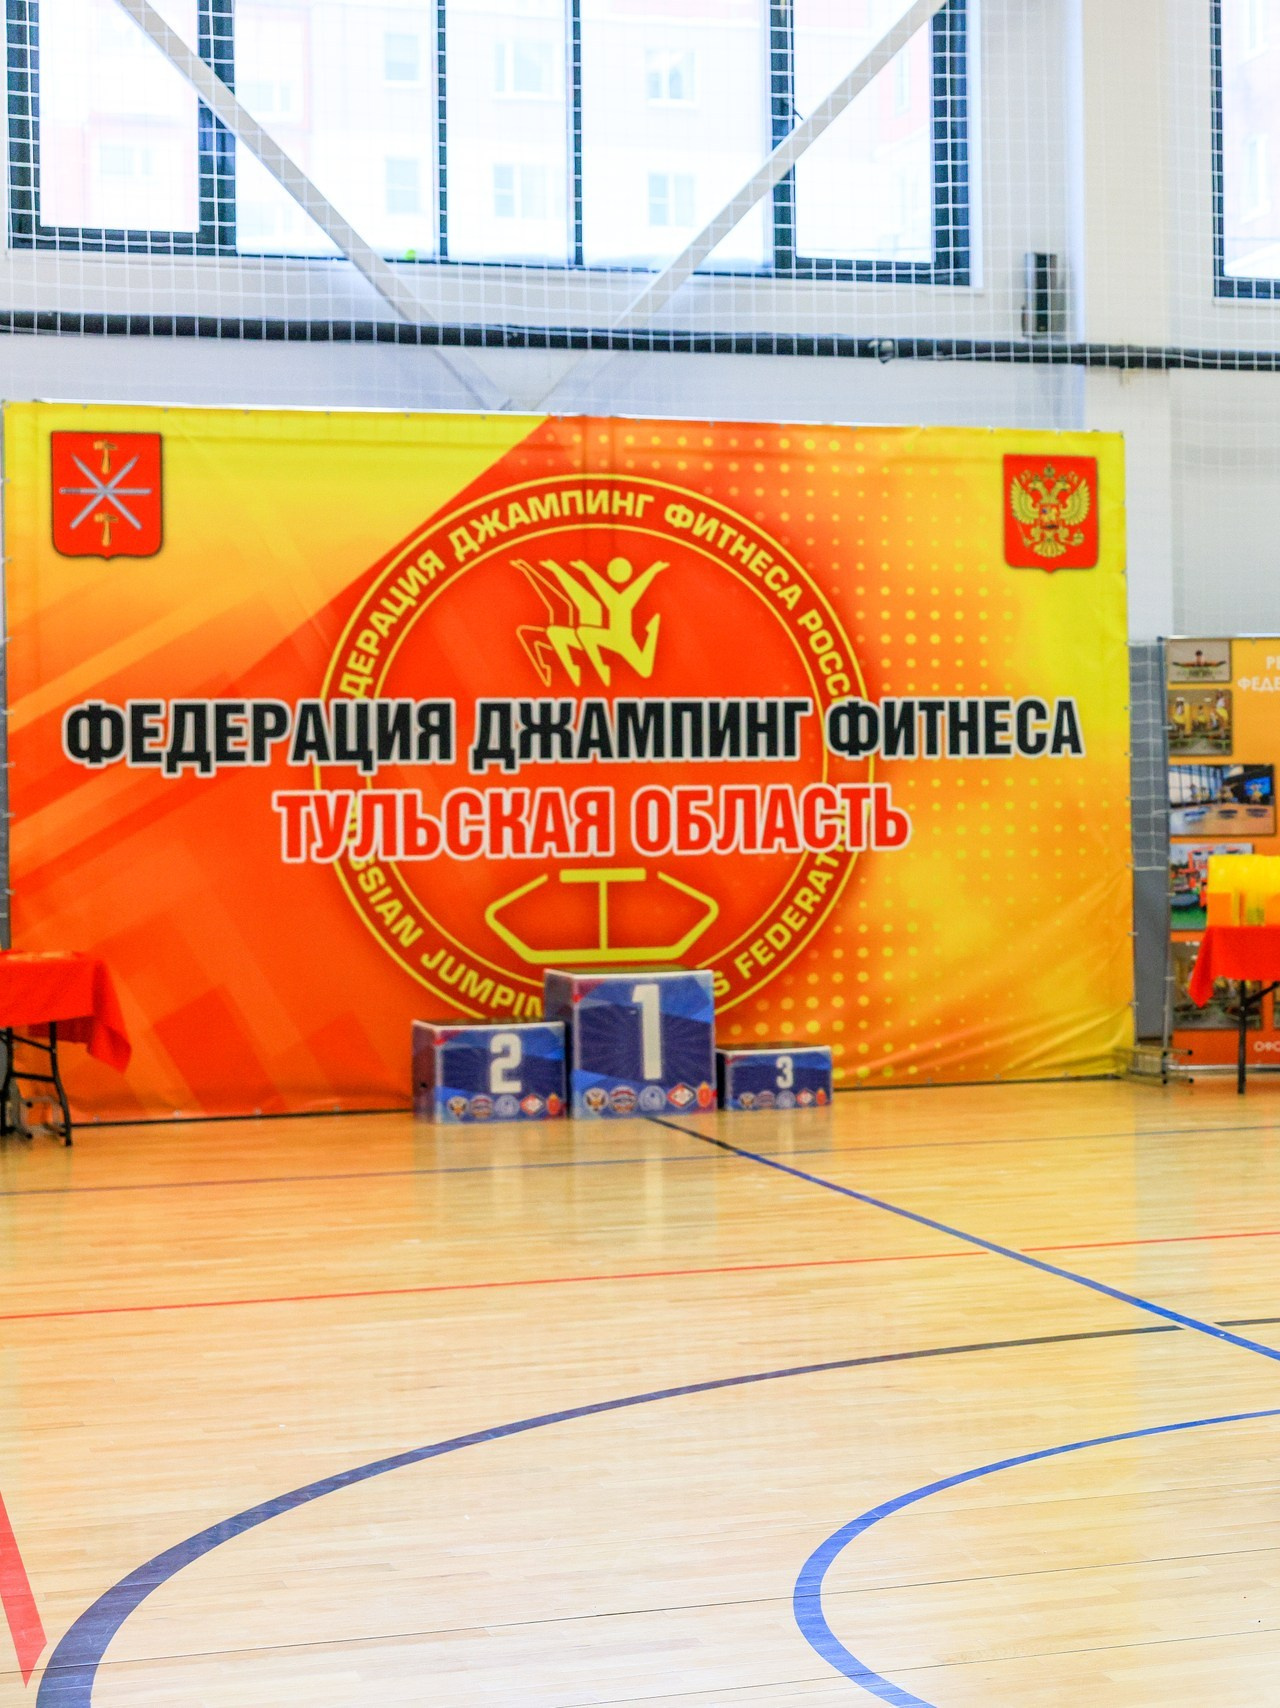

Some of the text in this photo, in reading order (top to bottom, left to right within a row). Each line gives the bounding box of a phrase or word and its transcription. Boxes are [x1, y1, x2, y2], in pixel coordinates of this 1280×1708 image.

[339, 488, 851, 702] ДЕРАЦИЯ ДЖАМПИНГ ФИТНЕСА РОСС
[64, 696, 1085, 778] ФЕДЕРАЦИЯ ДЖАМПИНГ ФИТНЕСА
[272, 783, 912, 864] ТУЛЬСКАЯ ОБЛАСТЬ
[733, 851, 840, 979] FEDERAT
[420, 948, 544, 1018] JUMPIN
[489, 1033, 523, 1094] 2
[632, 984, 662, 1081] 1
[775, 1056, 794, 1089] 3
